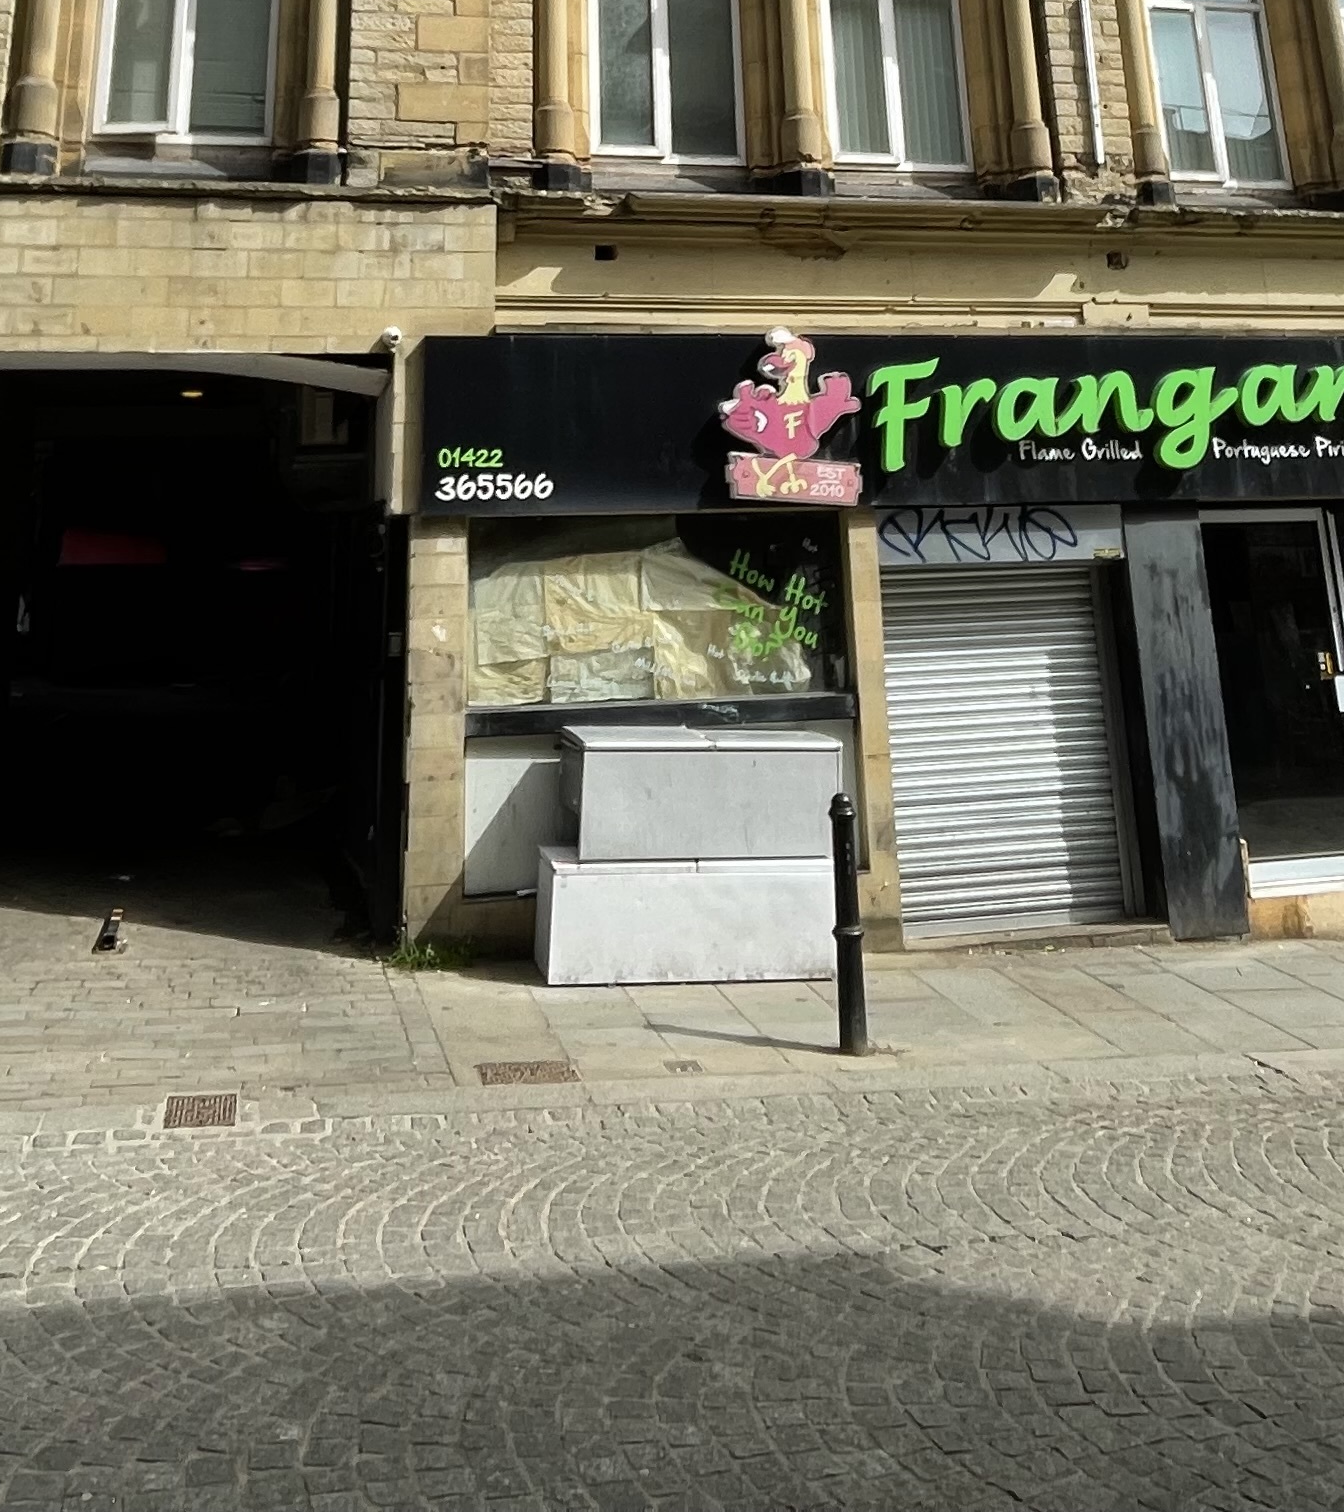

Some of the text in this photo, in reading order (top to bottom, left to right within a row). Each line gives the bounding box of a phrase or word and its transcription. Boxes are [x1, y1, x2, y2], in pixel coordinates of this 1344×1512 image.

[783, 410, 804, 439] F
[438, 446, 504, 469] 01422
[1019, 438, 1076, 462] Flame
[1081, 437, 1144, 462] Grilled
[1212, 436, 1311, 465] Portuguese
[434, 472, 554, 502] 365566
[816, 465, 847, 480] EST
[810, 483, 846, 498] 2010
[729, 548, 830, 615] How Hot
[774, 606, 818, 649] You
